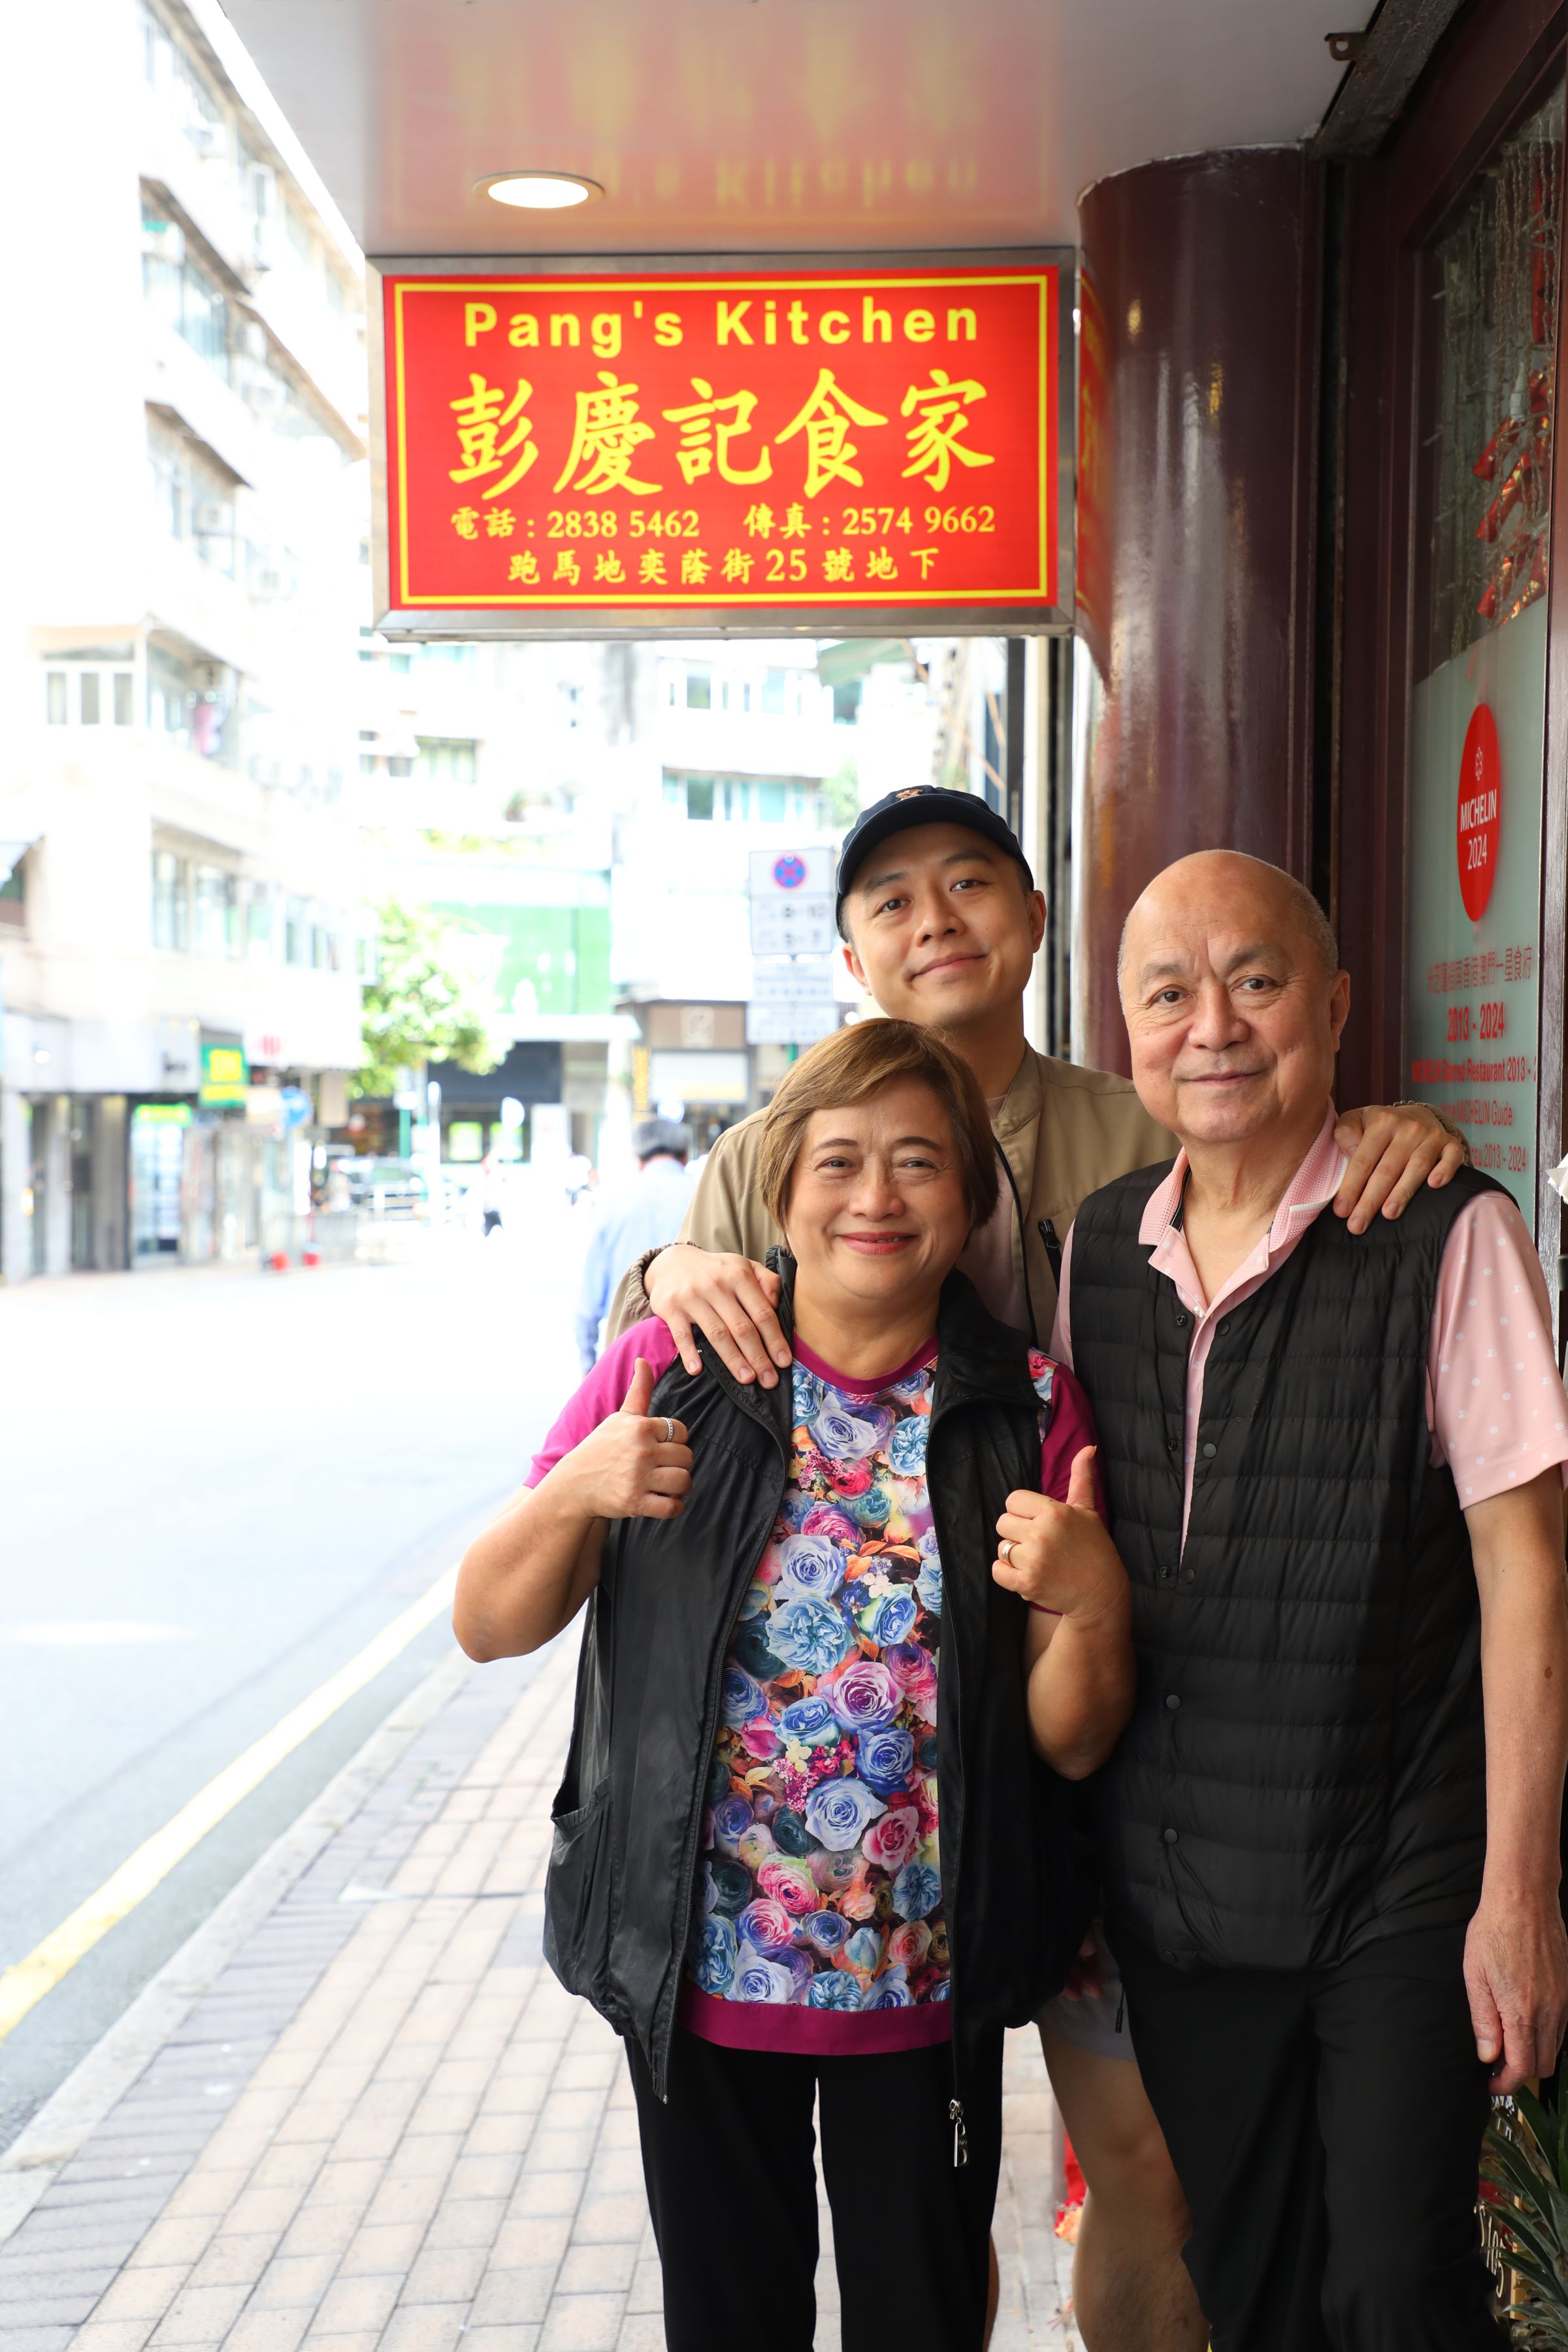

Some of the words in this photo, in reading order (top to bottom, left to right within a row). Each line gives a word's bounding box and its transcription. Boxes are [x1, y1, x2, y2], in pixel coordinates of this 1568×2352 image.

[465, 300, 684, 359] Pang's
[716, 295, 977, 346] Kitchen
[448, 367, 996, 501] 彭慶記食家
[546, 510, 619, 538] 2838
[629, 509, 700, 538] 5462
[841, 507, 914, 536] 2574
[924, 505, 995, 534] 9662
[1460, 789, 1497, 833] MICHELIN
[1467, 833, 1488, 870] 2024
[1447, 1006, 1470, 1043] 2013
[1479, 1002, 1505, 1040] 2024
[1467, 1057, 1506, 1083] Restaurant
[1507, 1055, 1526, 1083] 2013
[1457, 1098, 1490, 1125] MICHELIN
[1492, 1100, 1513, 1127] Guide
[1484, 1142, 1501, 1169] 2013
[1508, 1145, 1527, 1172] 2024
